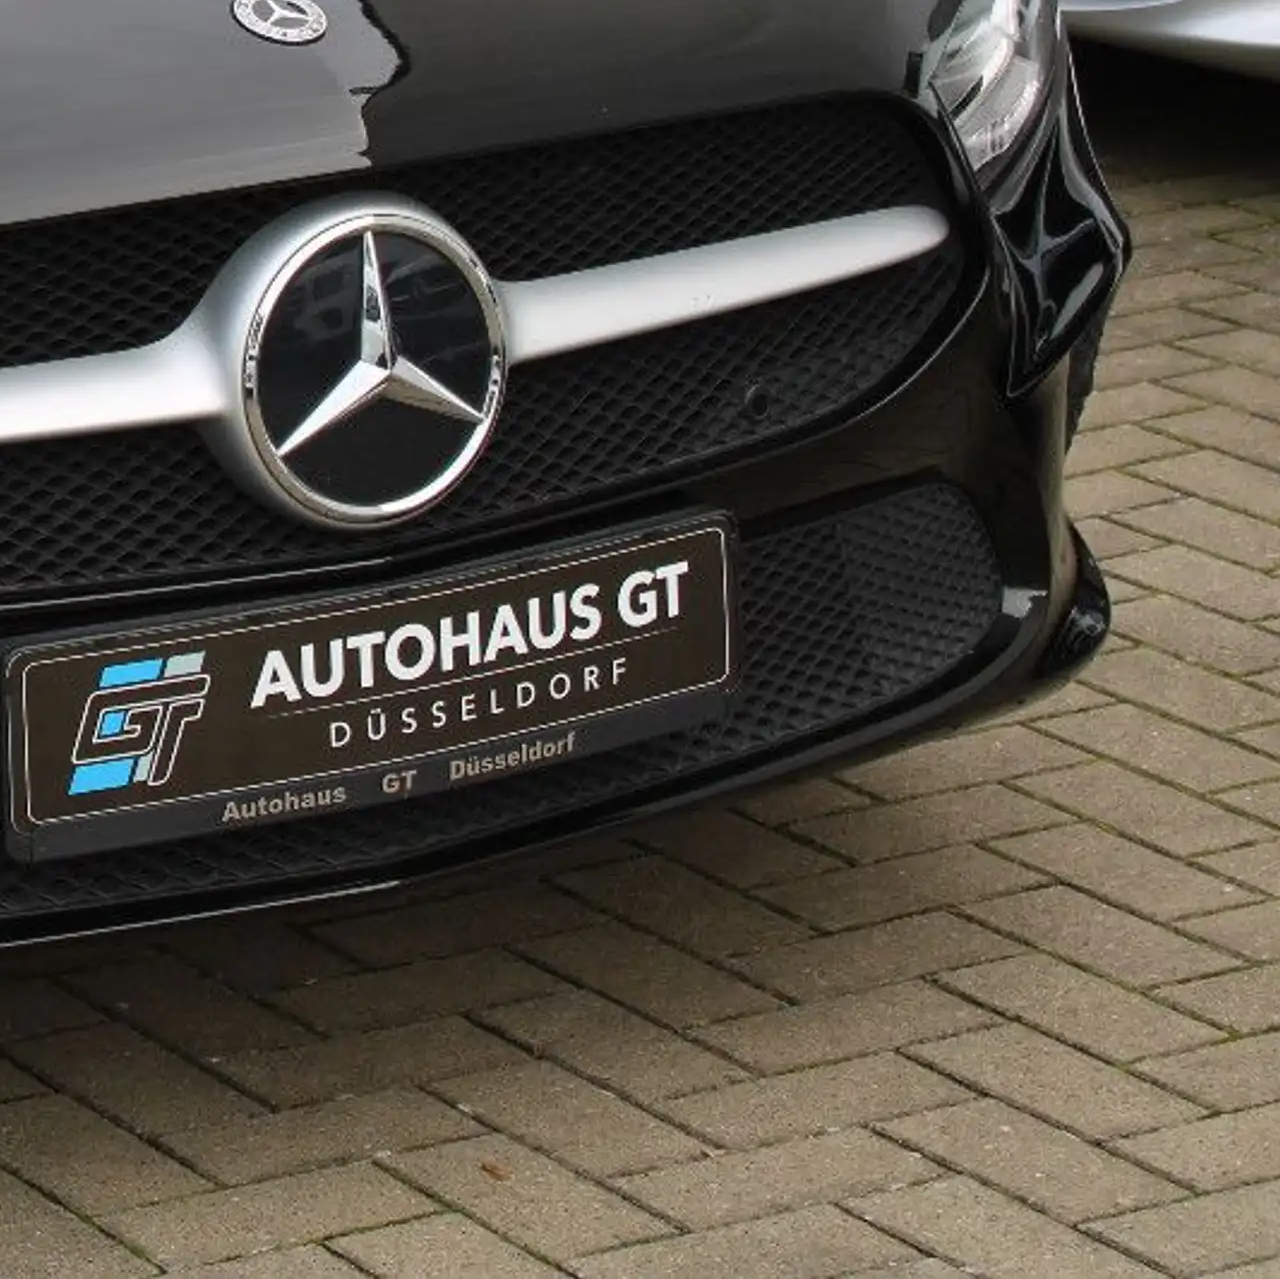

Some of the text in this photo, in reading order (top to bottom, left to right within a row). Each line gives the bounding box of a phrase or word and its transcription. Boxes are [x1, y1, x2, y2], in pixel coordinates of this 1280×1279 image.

[250, 562, 690, 709] AUTOHAUS GT
[329, 657, 628, 749] DÜSSELDORF
[221, 731, 576, 822] Autohaus GT Düsseldorf
